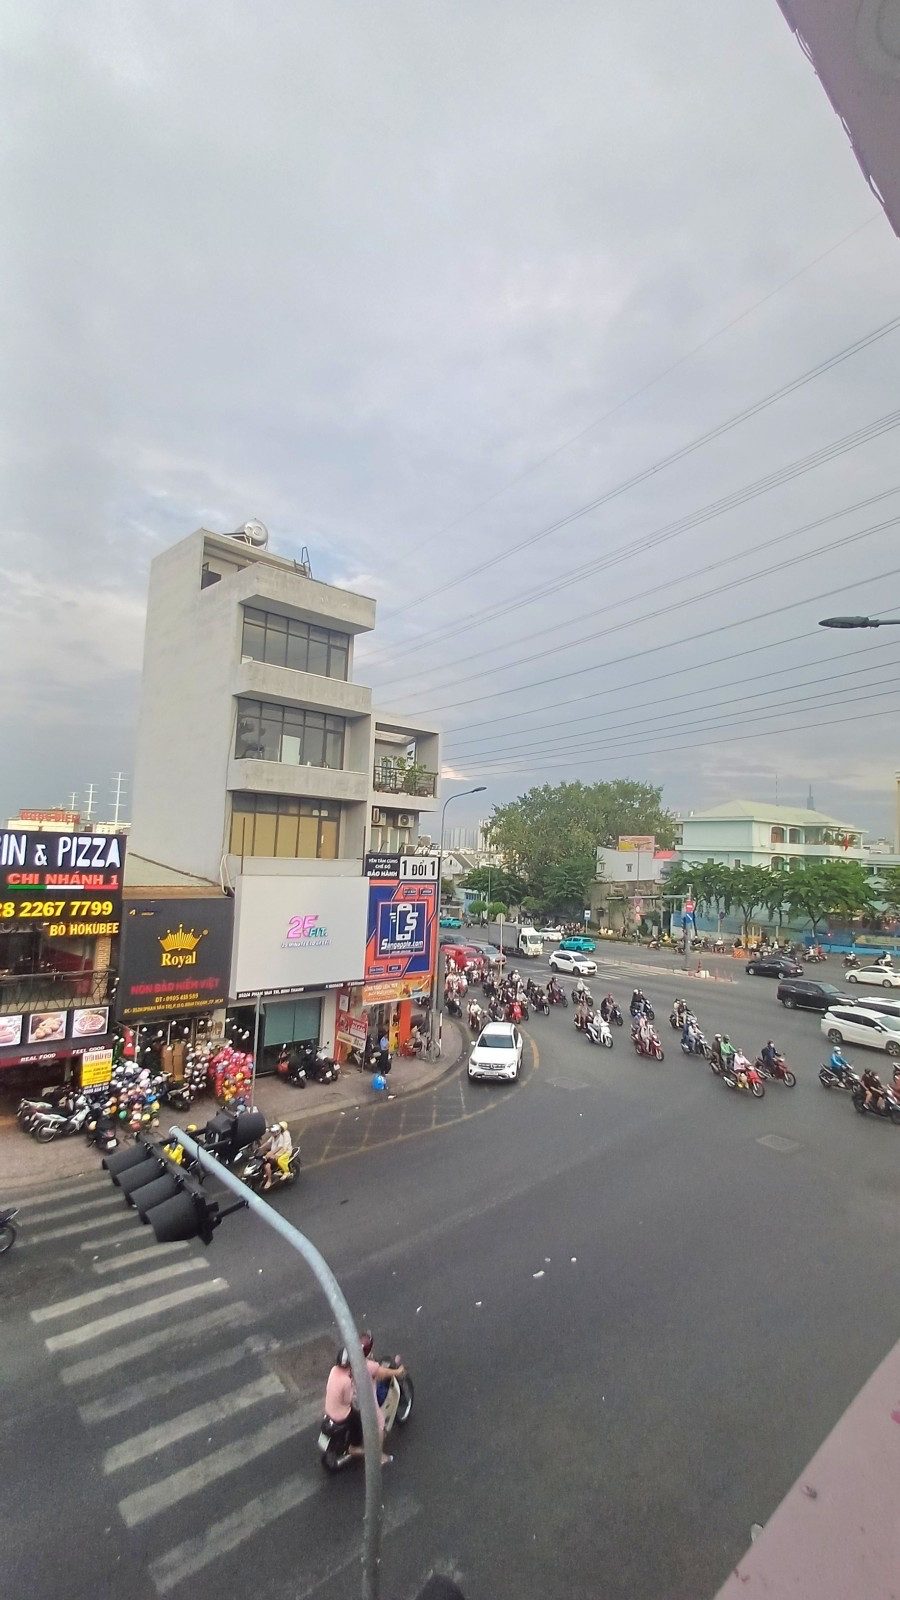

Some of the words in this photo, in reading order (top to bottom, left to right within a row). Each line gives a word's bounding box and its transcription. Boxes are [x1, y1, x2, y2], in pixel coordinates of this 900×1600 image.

[0, 834, 27, 866] IN
[34, 844, 48, 866] &
[57, 836, 121, 868] PIZZA
[402, 860, 408, 876] 1
[431, 860, 436, 876] 1
[7, 872, 40, 885] CHI
[45, 871, 104, 885] NHÁNH
[111, 875, 119, 885] 1
[0, 901, 15, 917] 8
[20, 901, 66, 917] 2267
[70, 901, 114, 916] 7799
[160, 951, 197, 968] Royal
